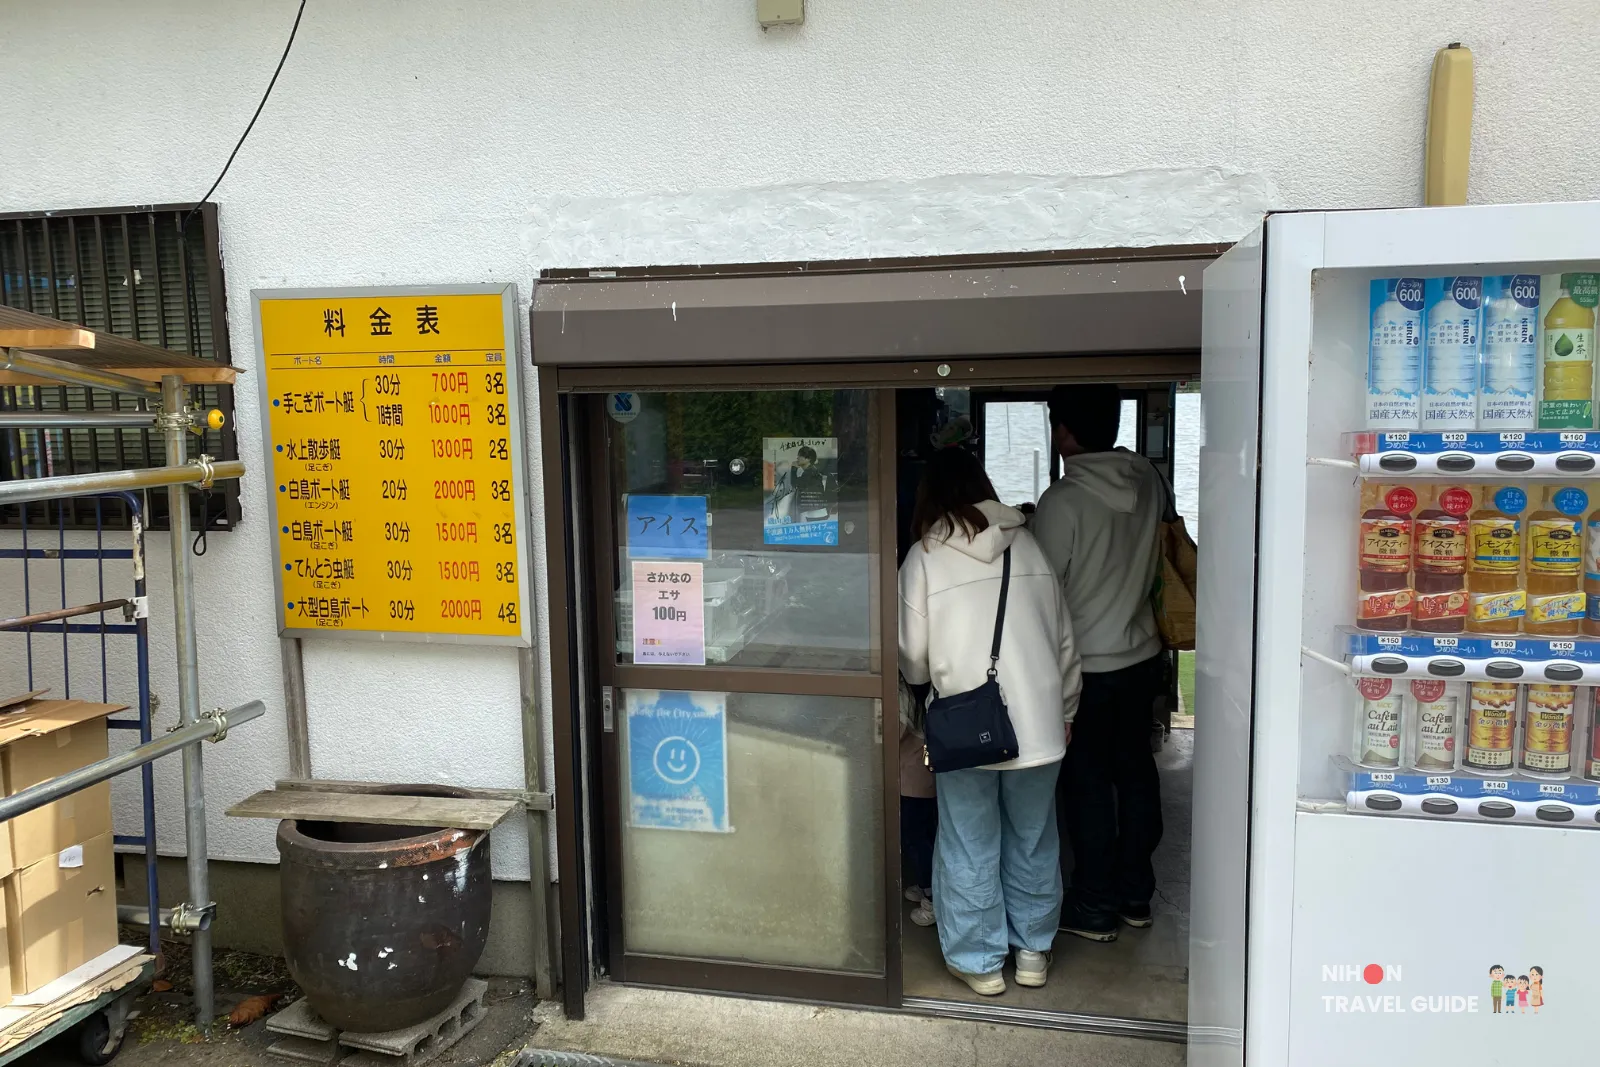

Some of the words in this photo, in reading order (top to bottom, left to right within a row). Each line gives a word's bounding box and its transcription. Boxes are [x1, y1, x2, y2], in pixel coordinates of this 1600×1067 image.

[1576, 332, 1586, 354] 生茶
[294, 355, 322, 365] ボート名
[378, 355, 395, 364] 時間
[435, 354, 451, 363] 金額
[485, 352, 502, 362] 定員
[375, 374, 400, 396] 30分
[431, 372, 469, 394] 700円
[485, 373, 505, 394] 3名
[283, 391, 355, 414] 手こぎボート艇
[376, 404, 403, 427] 1時間
[428, 403, 471, 425] 1000円
[487, 404, 506, 426] 3名
[1369, 409, 1418, 420] 国産天然水
[1425, 409, 1475, 420] 国産天然水
[1483, 409, 1533, 420] 国産天然水
[286, 438, 341, 460] 水上散歩艇
[379, 439, 405, 460] 30分
[431, 438, 473, 460] 1300円
[489, 439, 508, 461] 2名
[304, 463, 333, 472] (足こぎ)
[289, 479, 350, 500] 白鳥ボート艇
[382, 480, 407, 501] 20分
[434, 479, 475, 500] 2000円
[491, 480, 511, 502] 3名
[304, 501, 339, 510] (エンジン)
[636, 514, 699, 536] アイス
[291, 520, 353, 542] 白鳥ボート艇
[384, 522, 410, 543] 30分
[436, 522, 478, 543] 1500円
[493, 523, 513, 544] 3名
[309, 541, 338, 550] (足こぎ)
[1367, 538, 1408, 548] アイスティー
[1421, 540, 1464, 549] アイスティー
[1478, 540, 1520, 549] レモンティー
[1536, 541, 1580, 550] レモンティー
[294, 558, 354, 579] てんとう虫艇
[387, 560, 413, 580] 30分
[438, 561, 480, 582] 1500円
[496, 562, 515, 583] 3名
[647, 571, 692, 584] さかなの
[312, 581, 341, 590] (足こぎ)
[658, 589, 681, 601] エサ
[297, 597, 369, 618] 大型白鳥ボート
[389, 600, 415, 620] 30分
[441, 600, 482, 620] 2000円
[498, 602, 517, 623] 4名
[652, 606, 687, 621] 100円
[315, 618, 344, 627] (足こぎ)
[1362, 681, 1386, 689] クリーム
[1415, 683, 1439, 691] クリーム
[1368, 710, 1390, 723] Café
[1421, 712, 1444, 726] Café
[1380, 722, 1398, 731] Lait
[1435, 724, 1453, 734] Lait
